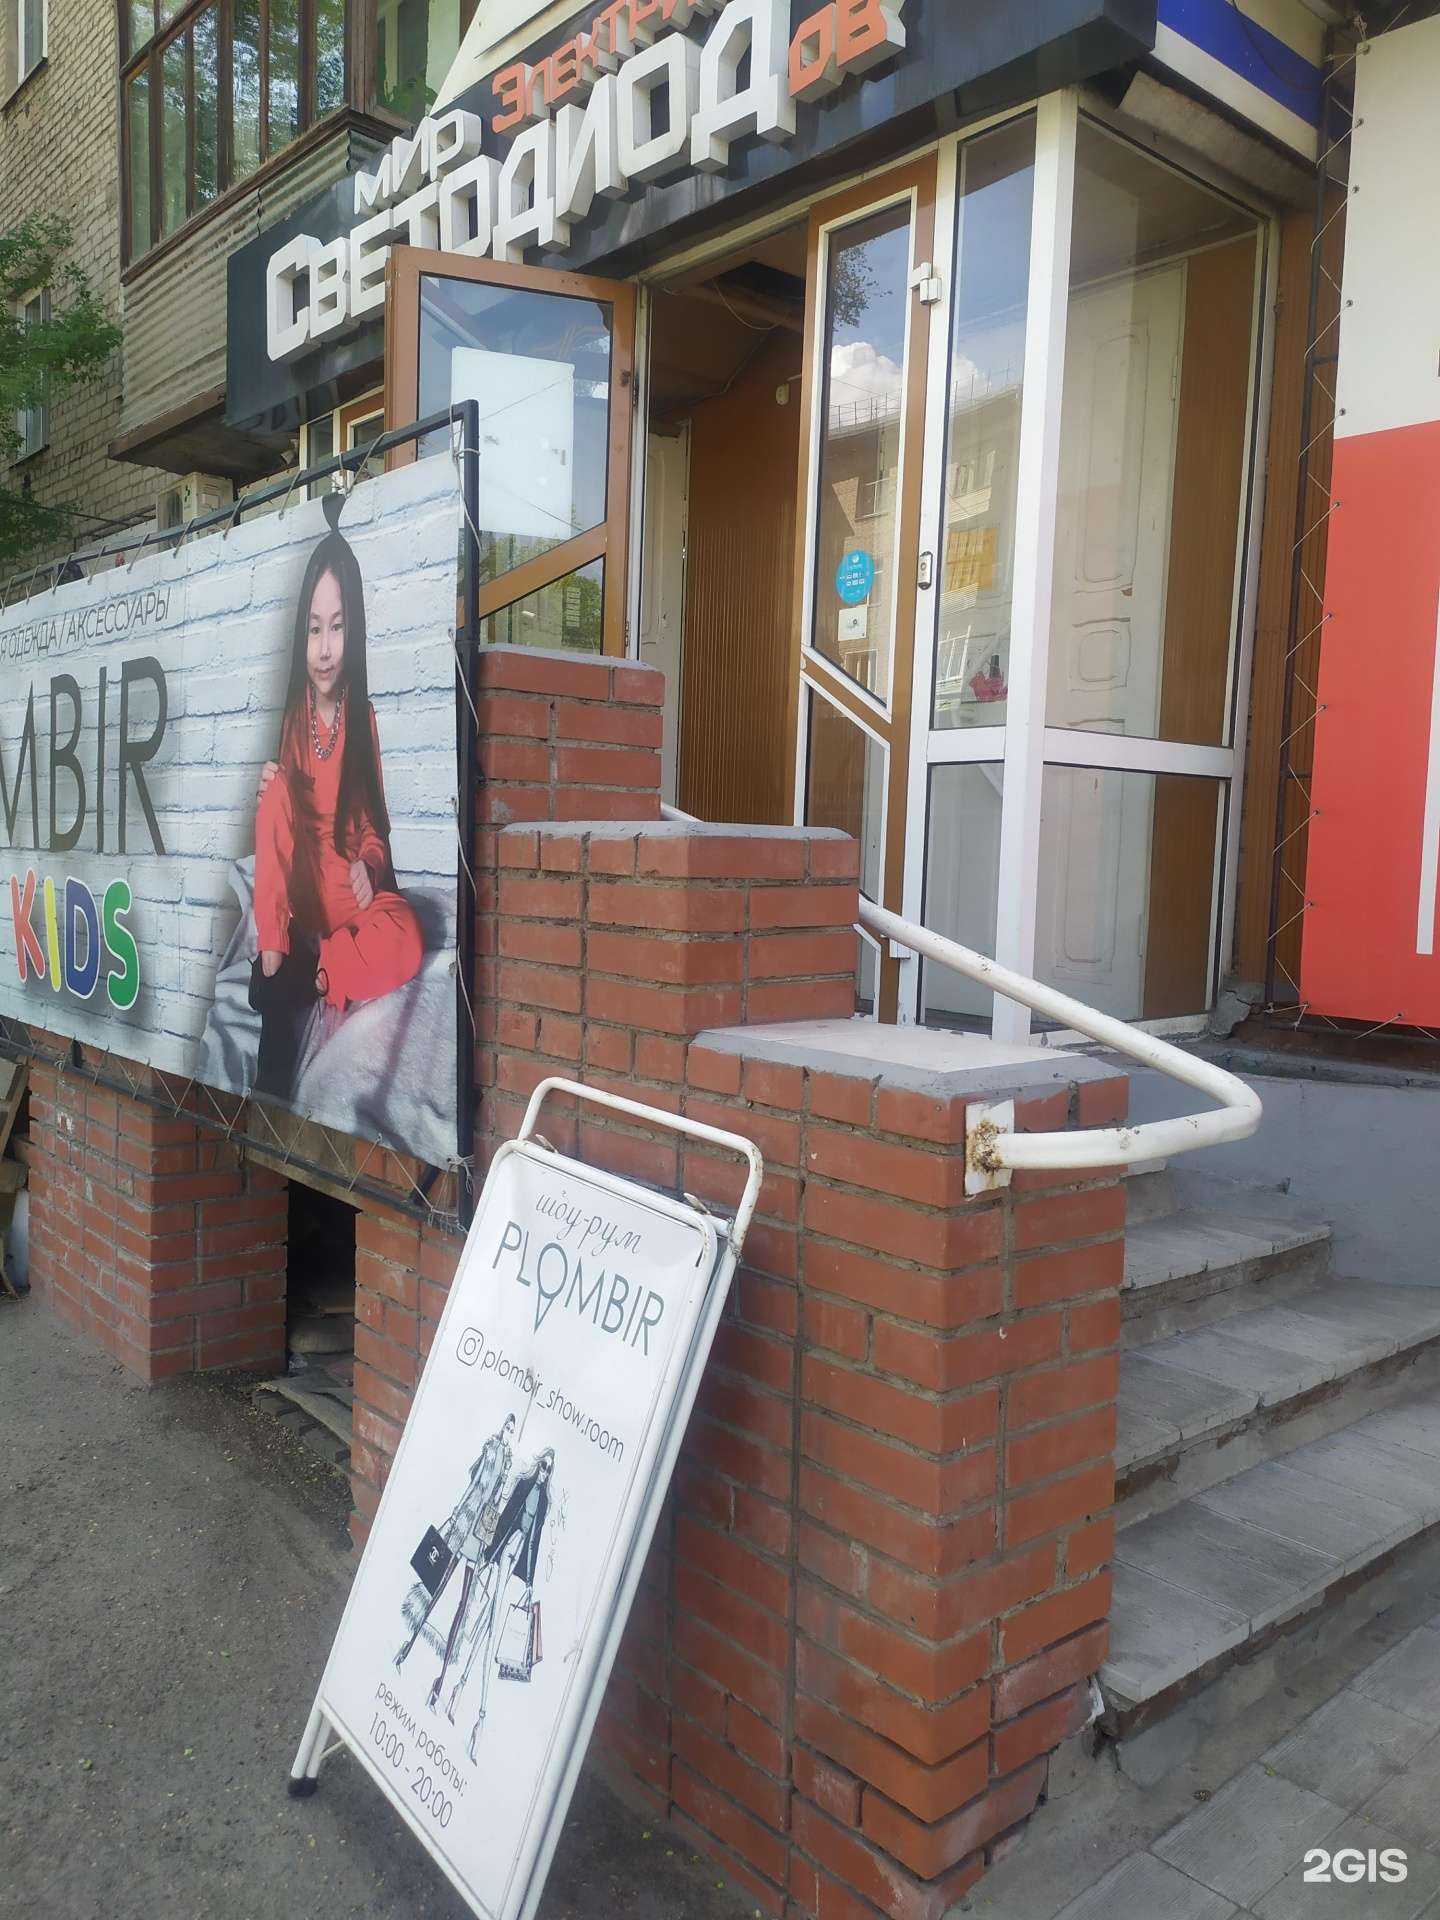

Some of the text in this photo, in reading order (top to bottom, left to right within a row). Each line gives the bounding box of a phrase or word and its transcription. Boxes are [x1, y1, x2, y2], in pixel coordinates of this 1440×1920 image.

[492, 0, 695, 134] ЭЛЕКТР
[354, 109, 481, 216] МИР
[9, 867, 140, 1011] KIDS
[491, 1220, 666, 1357] PLOMBIR
[369, 1711, 405, 1768] 10:00
[410, 1766, 453, 1828] 20:00
[375, 1682, 469, 1798] режим работы:
